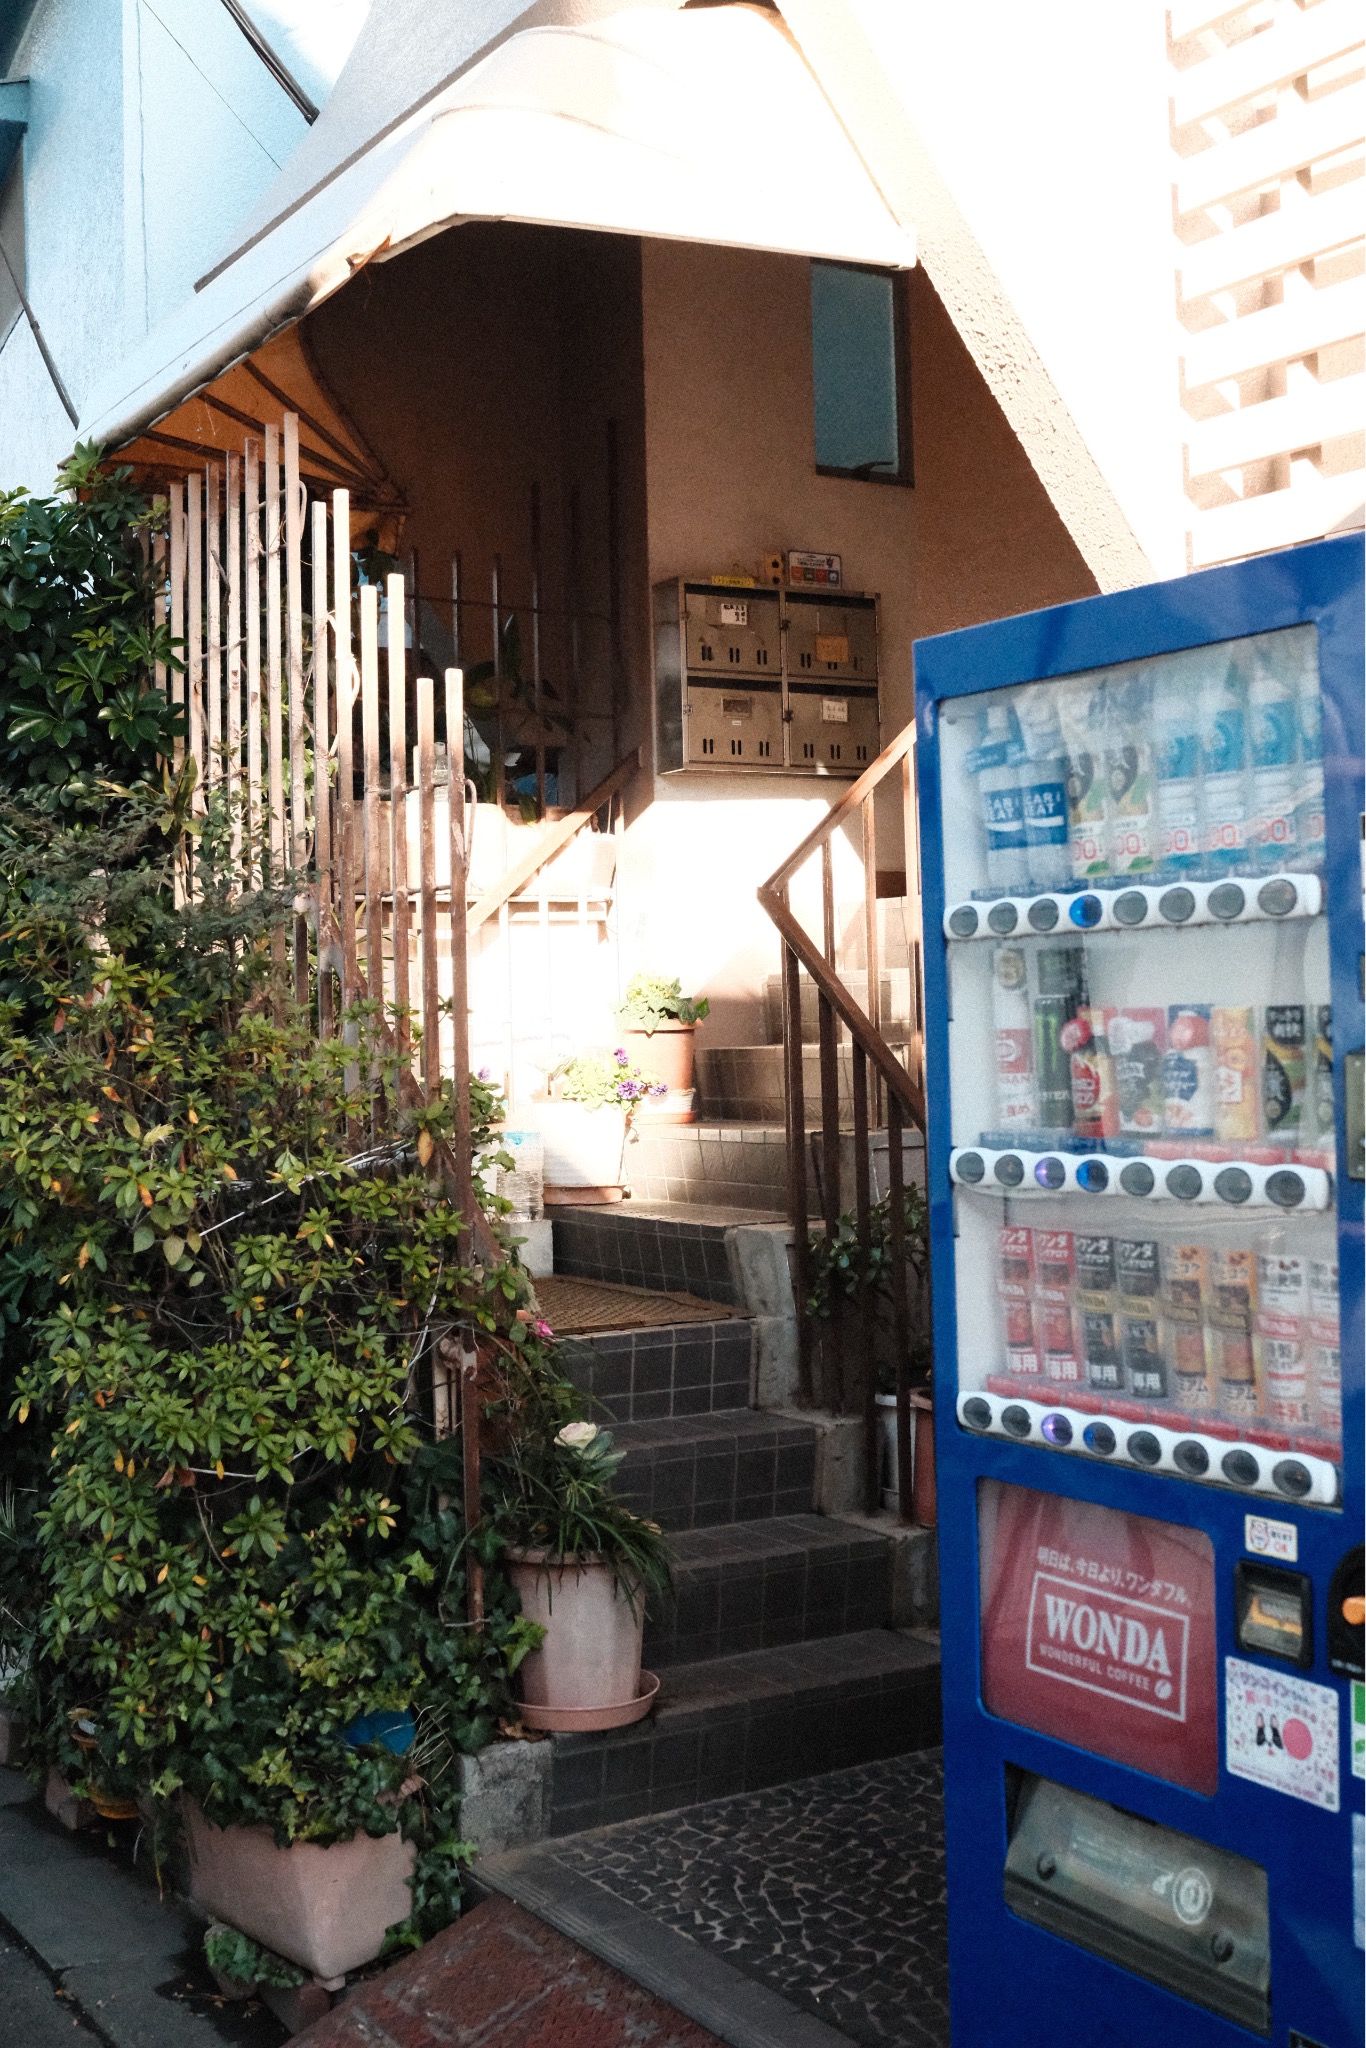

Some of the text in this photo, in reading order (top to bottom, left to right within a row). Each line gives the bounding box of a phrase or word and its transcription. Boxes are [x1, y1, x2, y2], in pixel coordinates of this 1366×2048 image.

[1039, 1642, 1150, 1691] WONDERFUL COFFEE
[1044, 1593, 1173, 1678] WONDA
